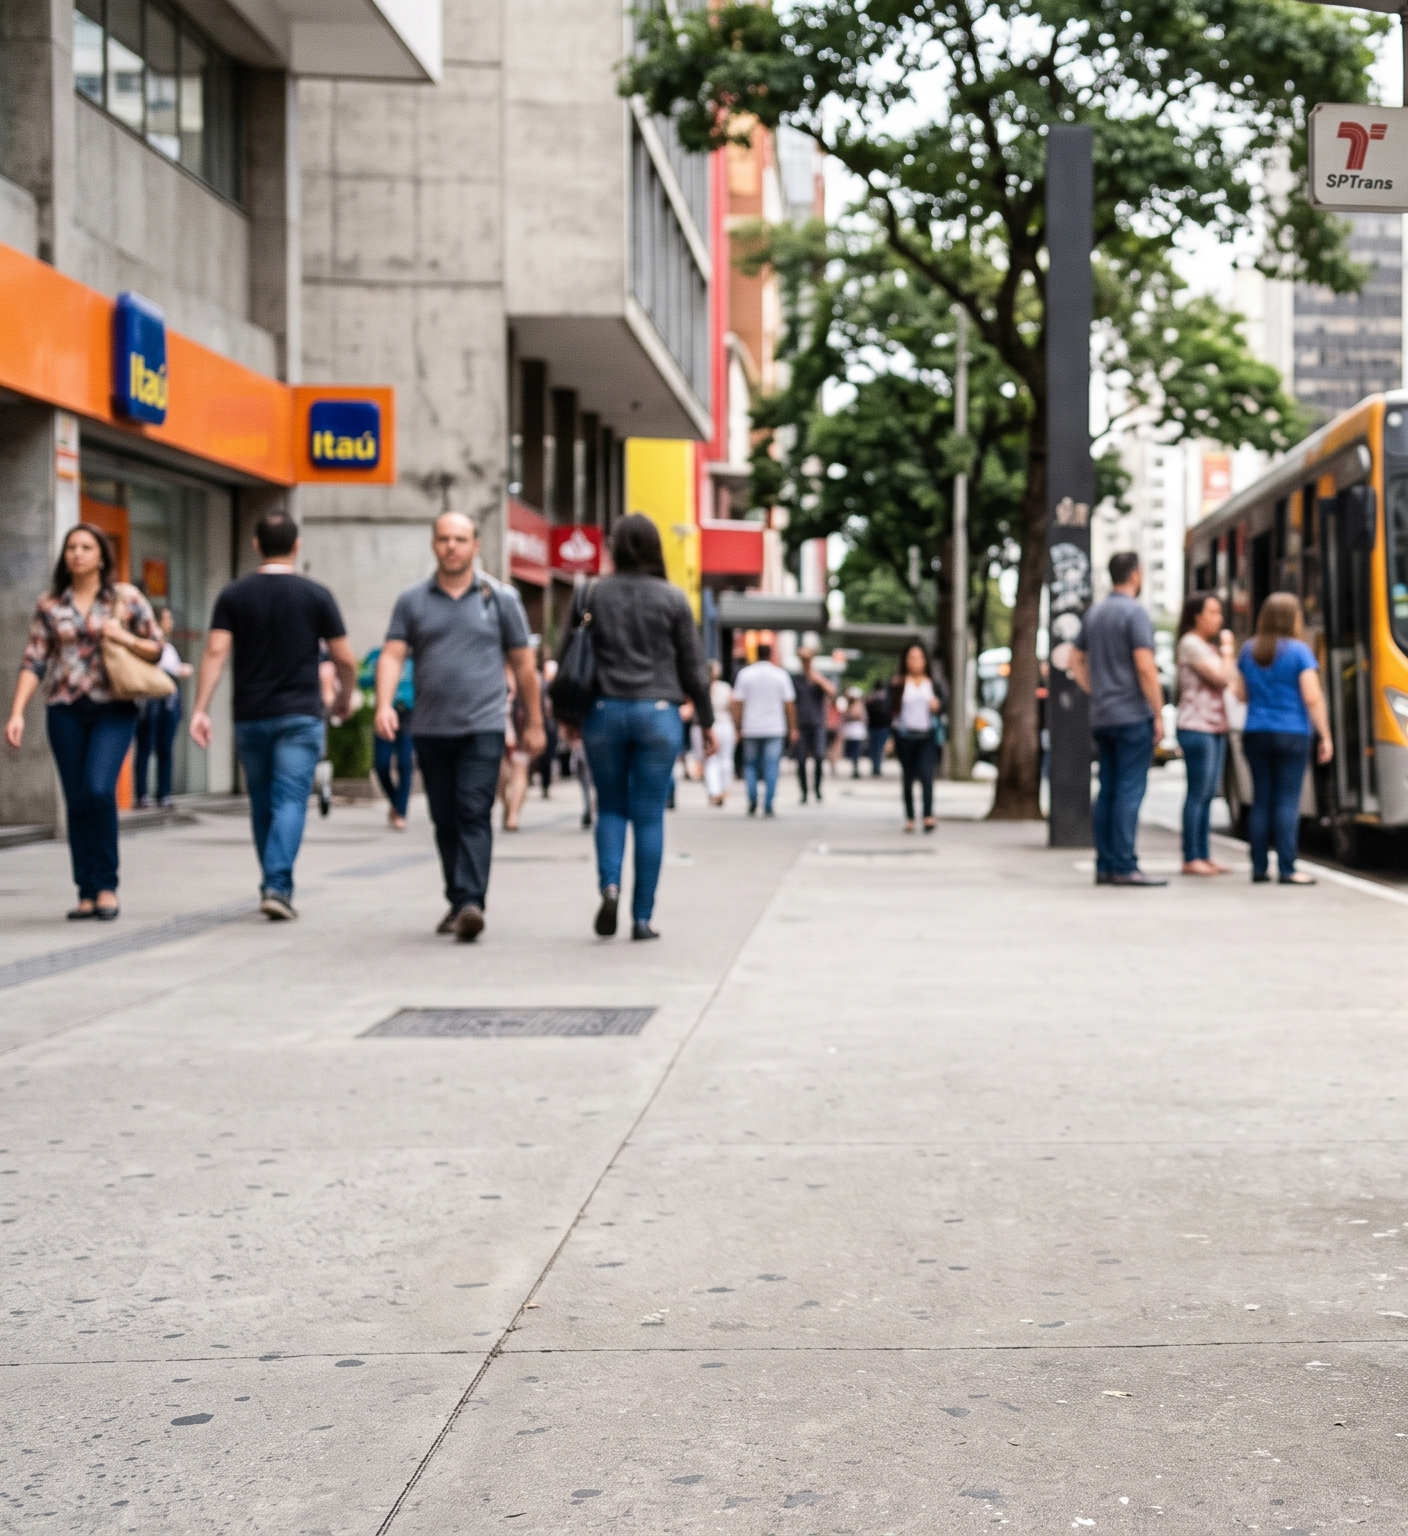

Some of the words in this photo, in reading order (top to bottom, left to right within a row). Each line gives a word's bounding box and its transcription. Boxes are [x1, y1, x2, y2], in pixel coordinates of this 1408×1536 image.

[1326, 173, 1393, 190] SPTrans
[130, 350, 167, 411] Itaú
[312, 430, 376, 461] Itaú
